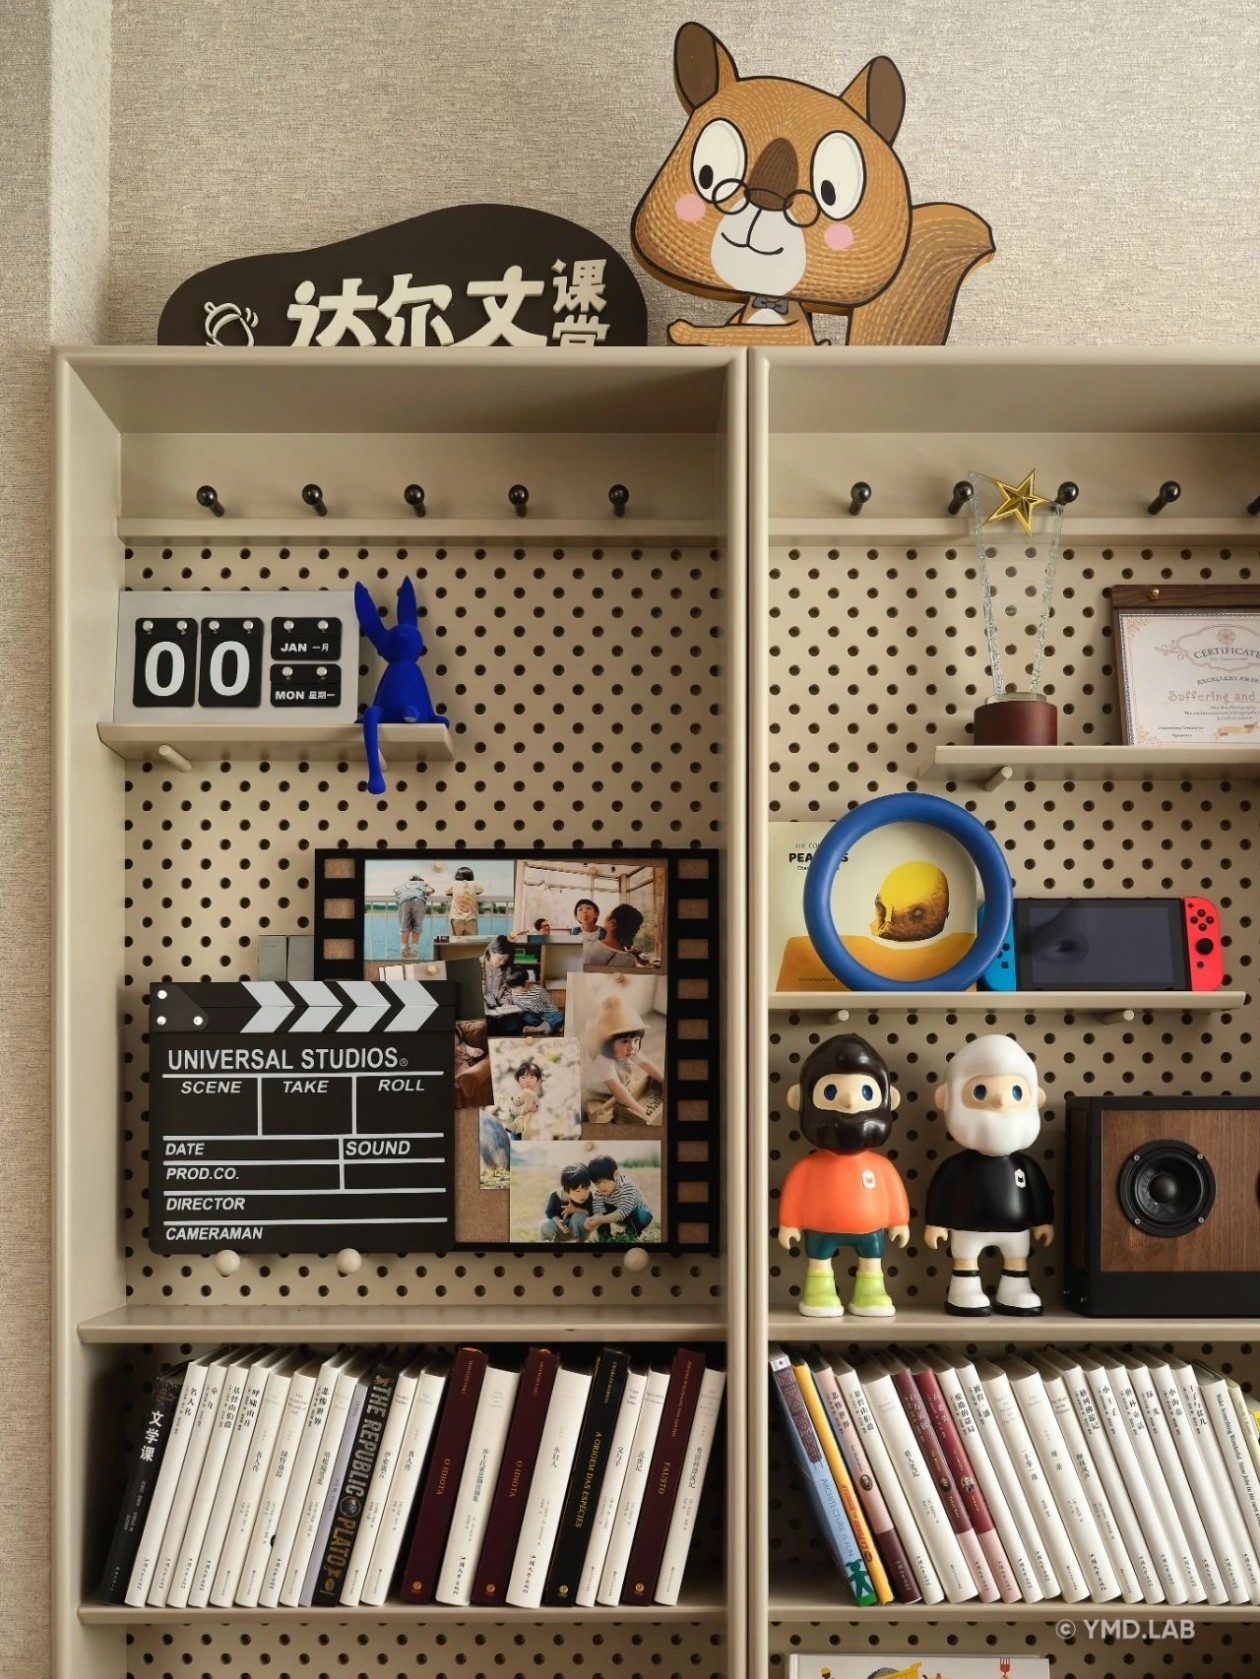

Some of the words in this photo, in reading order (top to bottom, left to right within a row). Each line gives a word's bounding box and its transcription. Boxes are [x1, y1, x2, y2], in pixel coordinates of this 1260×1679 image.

[286, 264, 548, 346] 达尔文
[280, 642, 307, 653] JAN
[312, 642, 329, 653] 一月
[1193, 646, 1260, 659] CERTIFICATE
[275, 690, 305, 700] MON
[308, 690, 335, 700] 星期一
[1168, 690, 1229, 704] Suffering
[1234, 691, 1256, 702] and
[788, 852, 849, 863] PEAS
[167, 1049, 294, 1070] UNIVERSAL
[180, 1081, 242, 1094] SCENE
[283, 1080, 329, 1093] TAKE
[378, 1079, 425, 1092] ROLL
[165, 1143, 205, 1156] DATE
[345, 1140, 411, 1156] SOUND
[166, 1167, 240, 1180] PROD.CO.
[166, 1197, 246, 1211] DIRECTOR
[165, 1227, 263, 1241] CAMERAMAN
[244, 1389, 260, 1427] 呼啸山庄
[366, 1386, 393, 1417] THE
[140, 1410, 164, 1462] 文学课
[345, 1418, 383, 1498] REPUBLIC
[587, 1438, 601, 1473] ORIGEM
[436, 1466, 449, 1495] IDIOTA
[509, 1468, 522, 1497] IDIOTA
[584, 1473, 594, 1490] DAS
[658, 1461, 671, 1495] FAUSTO
[820, 1479, 846, 1532] ARCHITECTURE
[843, 1541, 855, 1557] FUN
[326, 1516, 356, 1569] PLATO
